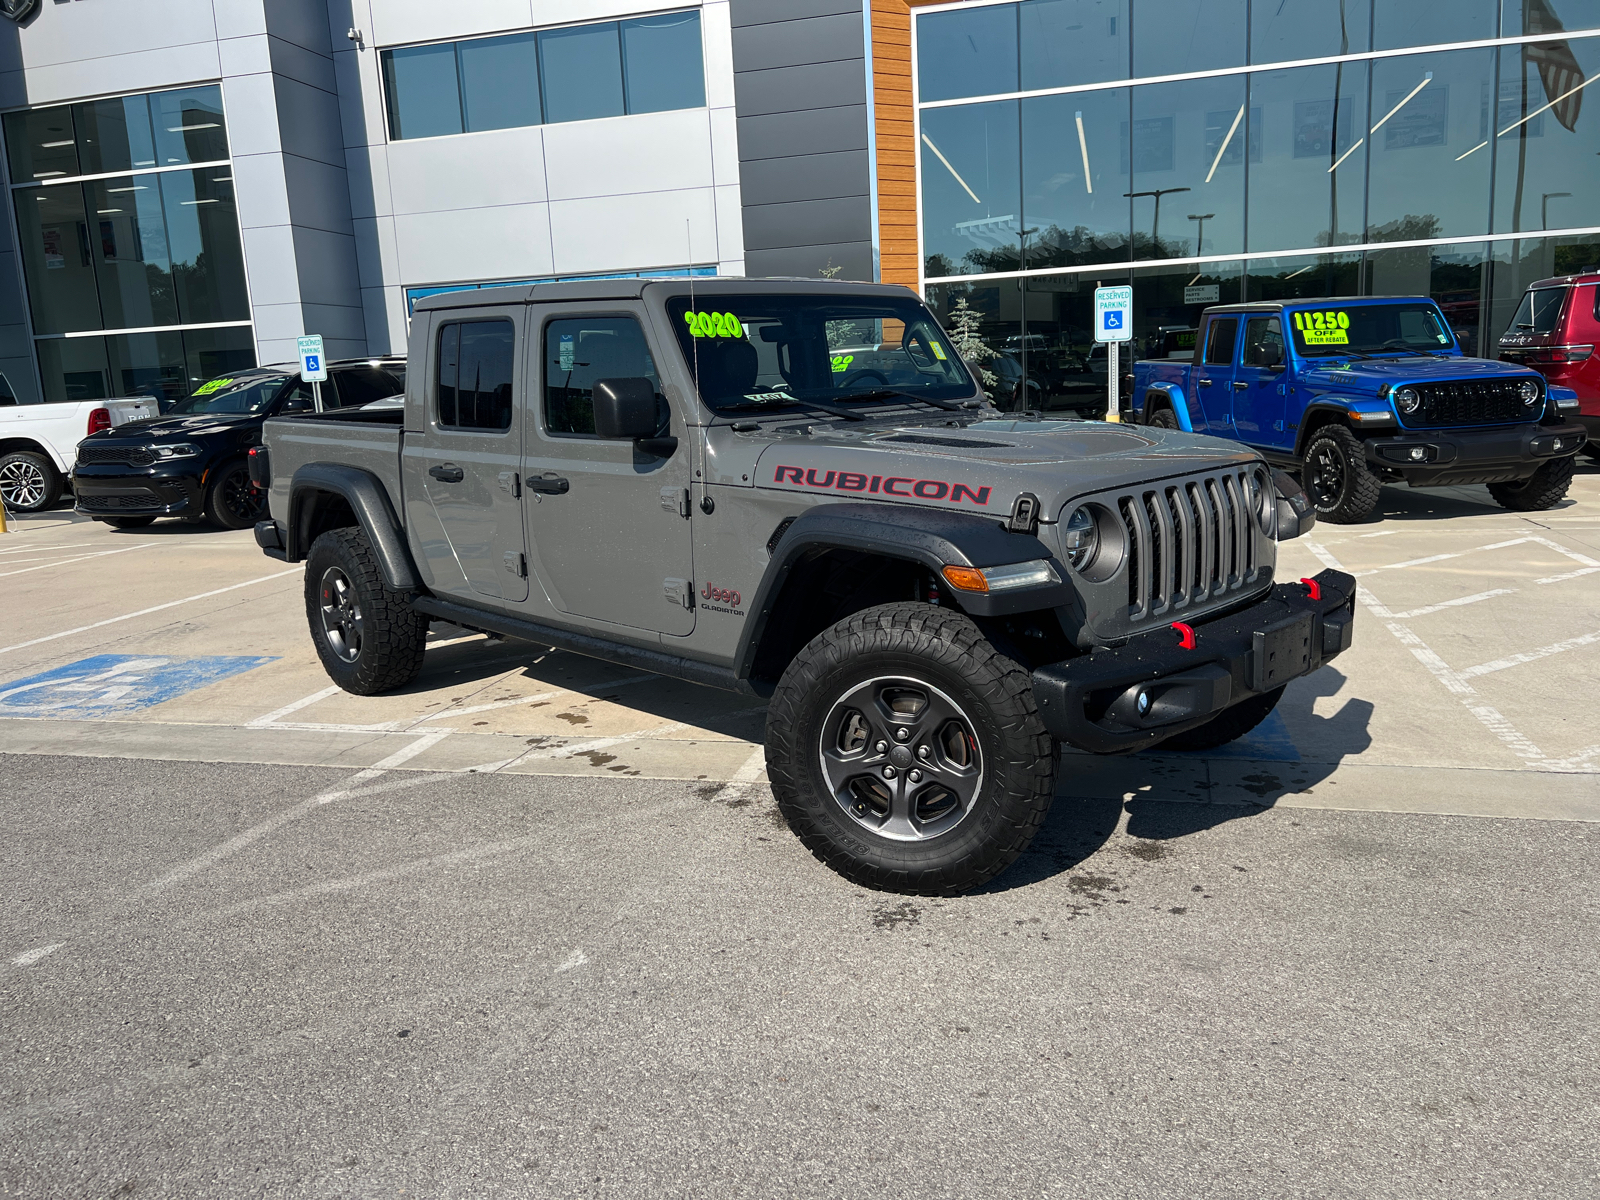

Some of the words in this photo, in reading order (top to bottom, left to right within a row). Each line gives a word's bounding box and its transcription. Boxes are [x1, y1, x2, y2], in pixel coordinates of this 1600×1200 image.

[1098, 292, 1129, 300] RESERVED
[1100, 301, 1127, 309] PARKING
[684, 311, 742, 338] 2020
[1294, 312, 1350, 330] 11250
[774, 465, 992, 506] RUBICON
[700, 582, 742, 608] Jeep
[702, 604, 744, 616] GLADIATOR
